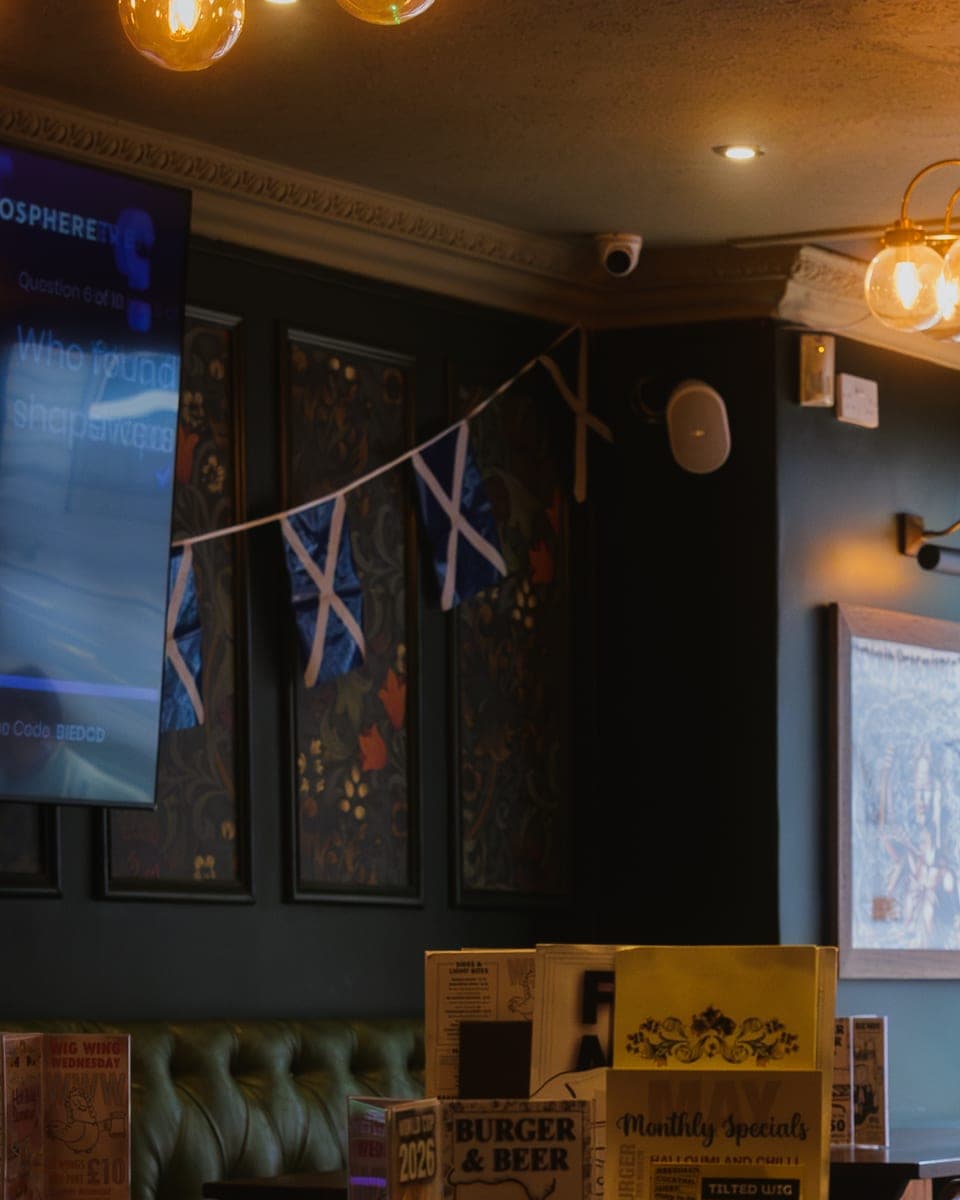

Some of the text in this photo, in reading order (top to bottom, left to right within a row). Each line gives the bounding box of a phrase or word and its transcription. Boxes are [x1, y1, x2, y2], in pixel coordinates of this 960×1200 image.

[18, 271, 80, 298] Question
[17, 324, 84, 371] Who
[83, 1041, 122, 1055] WING
[52, 1056, 121, 1069] WEDNESDAY
[455, 1117, 577, 1142] BURGER
[616, 1112, 716, 1147] Monthly
[721, 1112, 810, 1146] Specials
[88, 1158, 127, 1185] £10
[399, 1136, 436, 1183] 2026
[461, 1148, 570, 1173] & BEER
[708, 1183, 793, 1196] TILTED WIG
